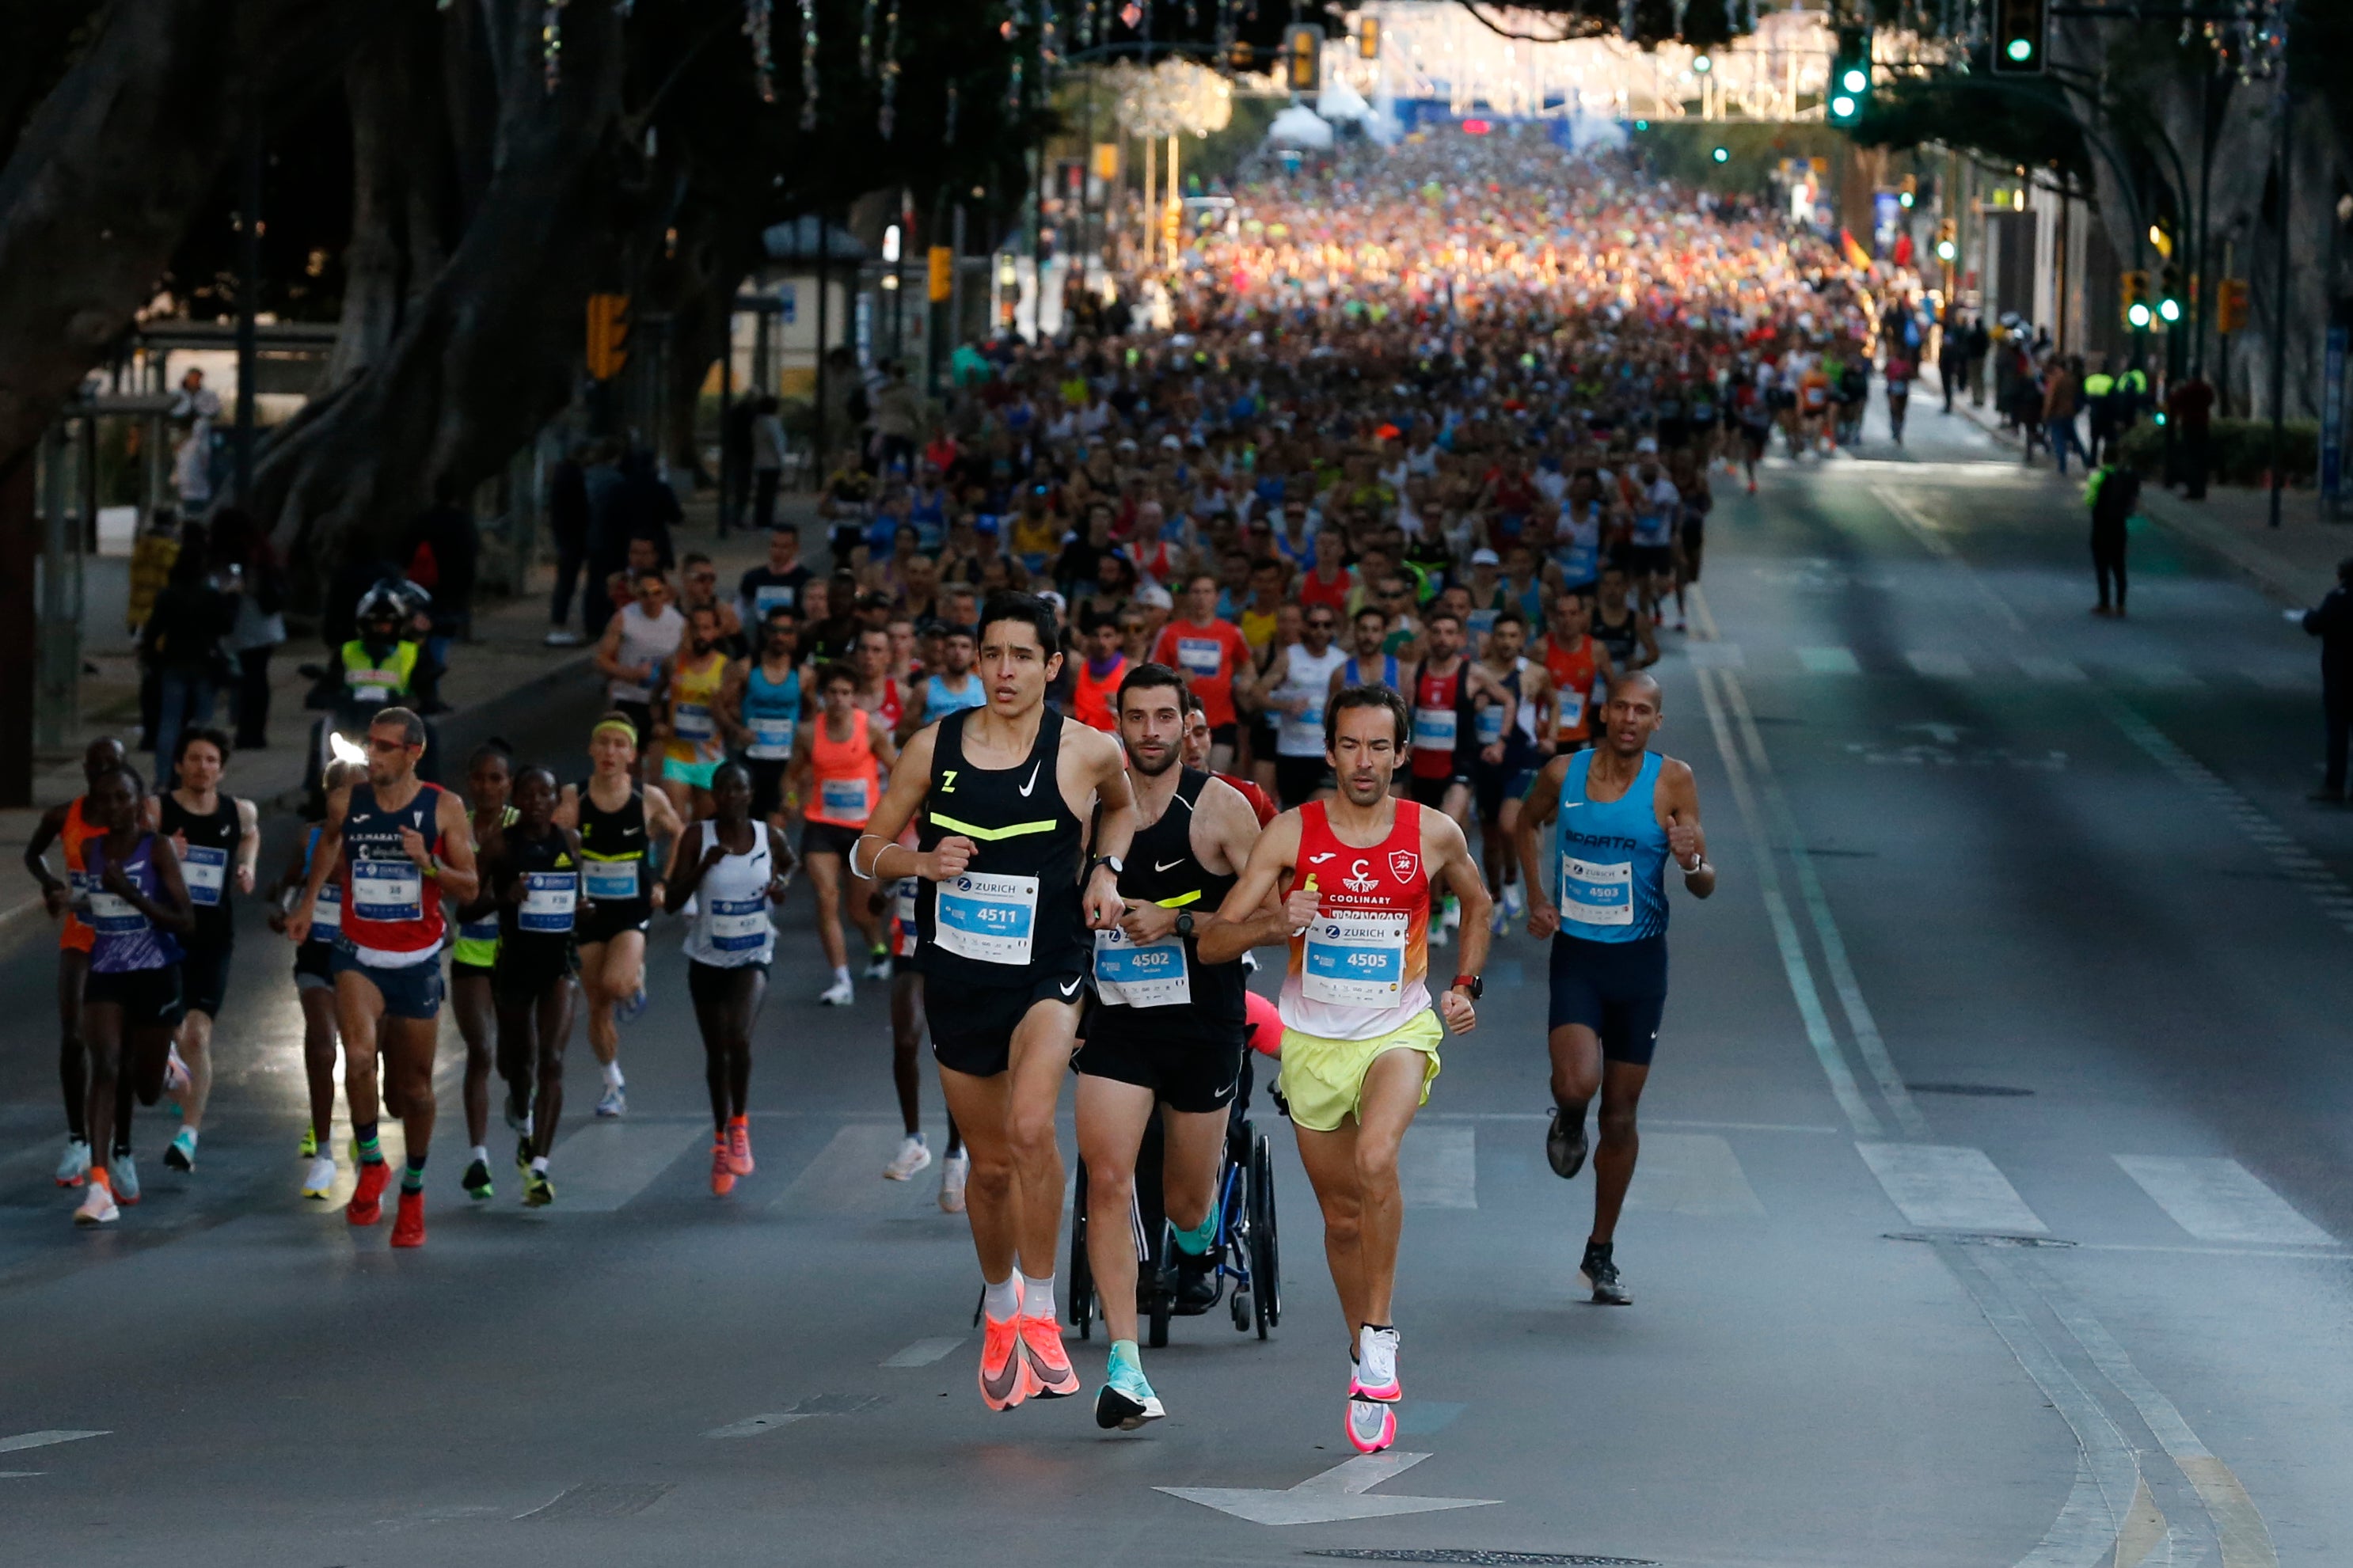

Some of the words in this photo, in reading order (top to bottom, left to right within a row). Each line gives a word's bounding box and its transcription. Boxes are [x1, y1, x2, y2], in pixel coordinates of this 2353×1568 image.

[1565, 830, 1636, 851] SPARTA
[1586, 869, 1615, 878] ZURICH
[975, 883, 1016, 894] ZURICH
[1590, 887, 1619, 898] 4503
[1330, 894, 1391, 905] COOLINARY
[977, 908, 1017, 923] 4511
[1344, 928, 1385, 938] ZURICH
[1132, 952, 1169, 966] 4502
[1347, 953, 1388, 967] 4505
